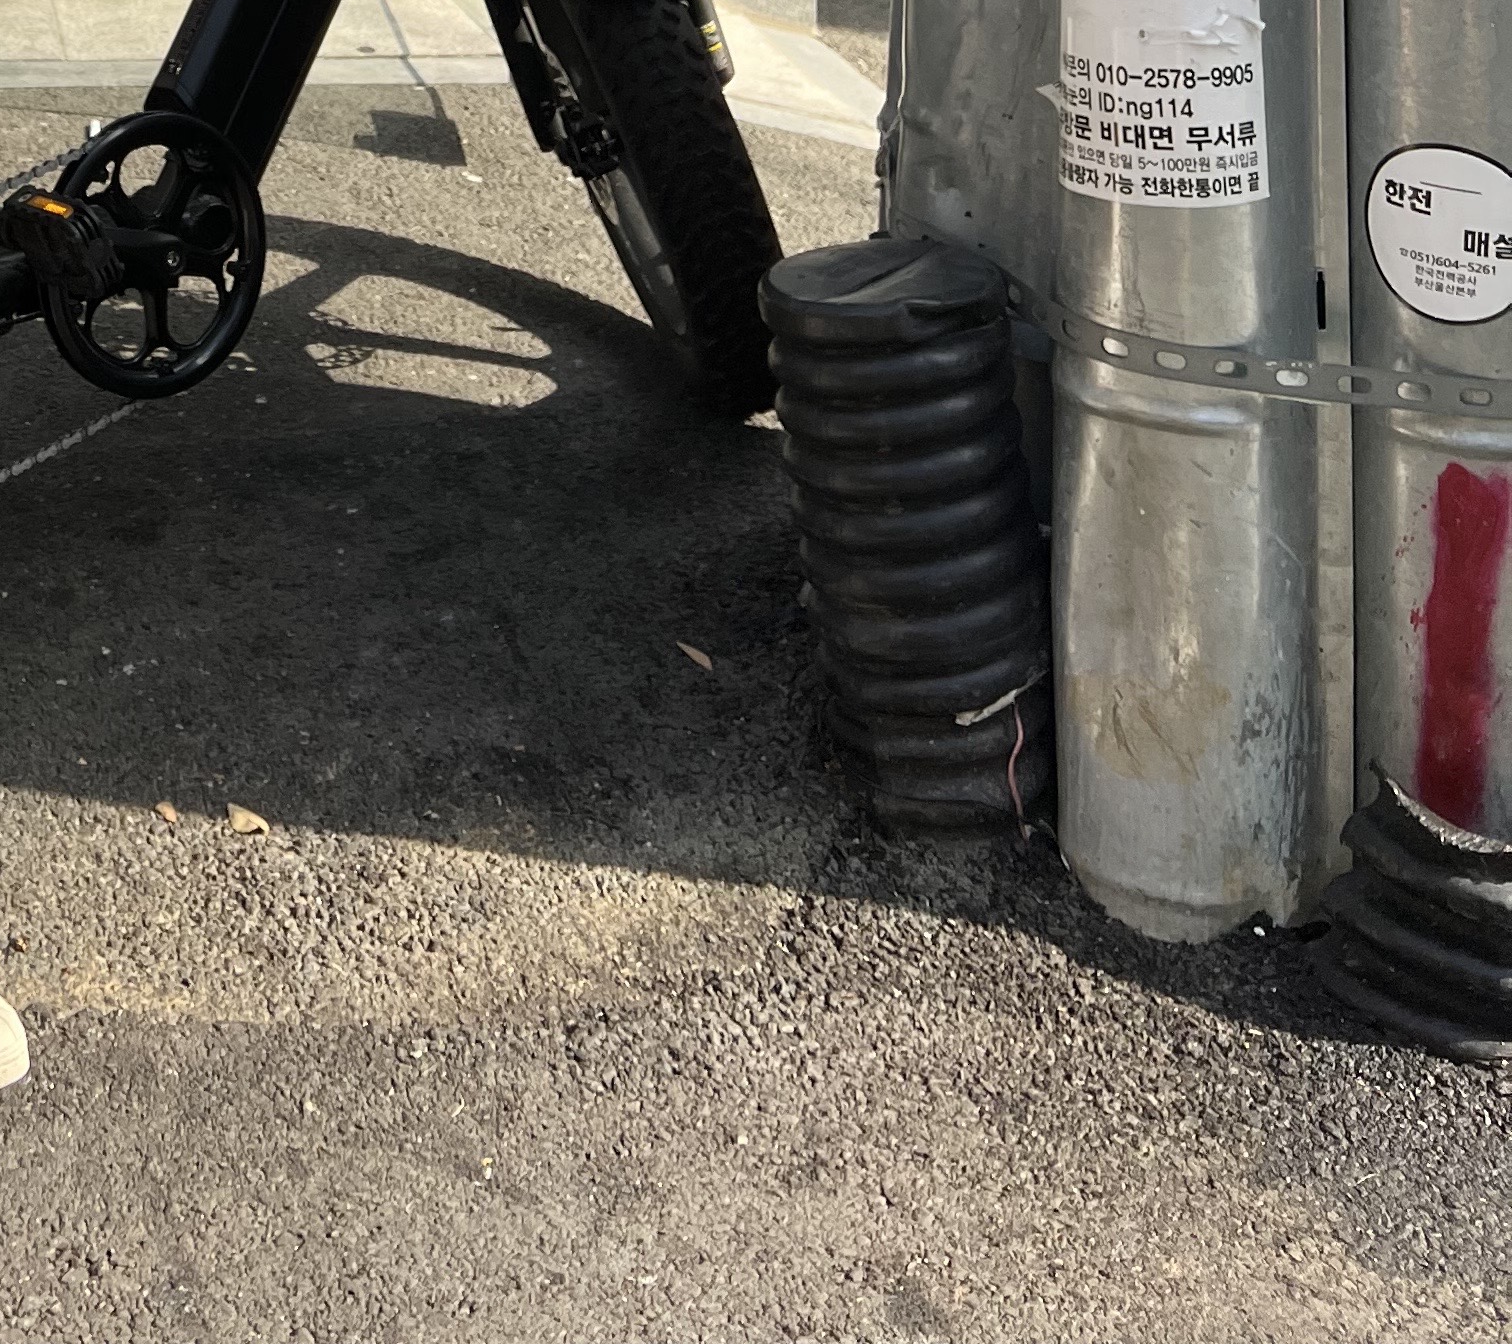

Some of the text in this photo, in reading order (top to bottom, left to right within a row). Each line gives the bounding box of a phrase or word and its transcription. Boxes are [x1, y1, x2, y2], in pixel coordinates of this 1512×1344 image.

[1063, 50, 1254, 89] 문의 010-2578-9905
[1098, 93, 1194, 120] ID:ng114
[1060, 109, 1257, 151] 방문 비대면 무서류
[1109, 152, 1133, 170] 당일
[1216, 151, 1258, 170] 즉시입금
[1104, 172, 1134, 195] 가능
[1141, 174, 1242, 198] 전화한통이면
[1247, 171, 1259, 192] 끝
[1385, 179, 1431, 216] 한전
